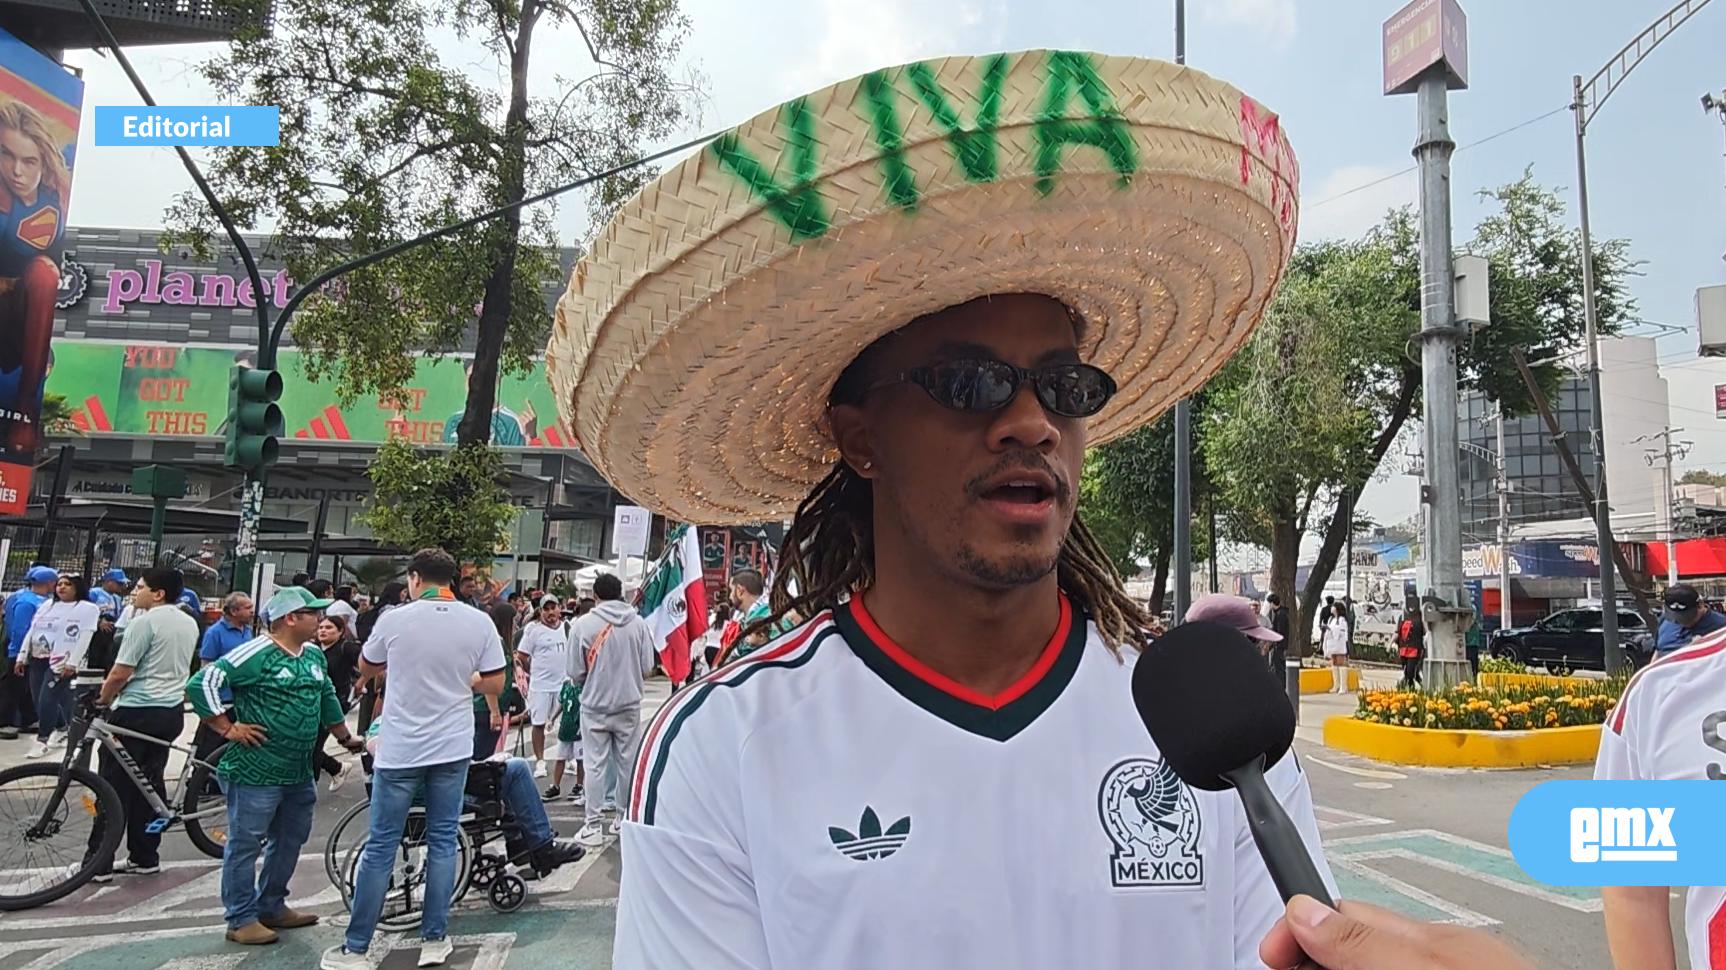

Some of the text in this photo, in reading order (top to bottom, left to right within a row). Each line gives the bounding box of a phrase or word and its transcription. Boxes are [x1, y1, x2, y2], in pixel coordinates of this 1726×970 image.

[709, 50, 1138, 240] VIVA
[103, 260, 293, 314] planet
[124, 346, 177, 369] YOU
[139, 379, 190, 402] GOT
[378, 389, 427, 412] GT
[147, 411, 207, 435] THIS
[1117, 857, 1198, 881] MÉXICO
